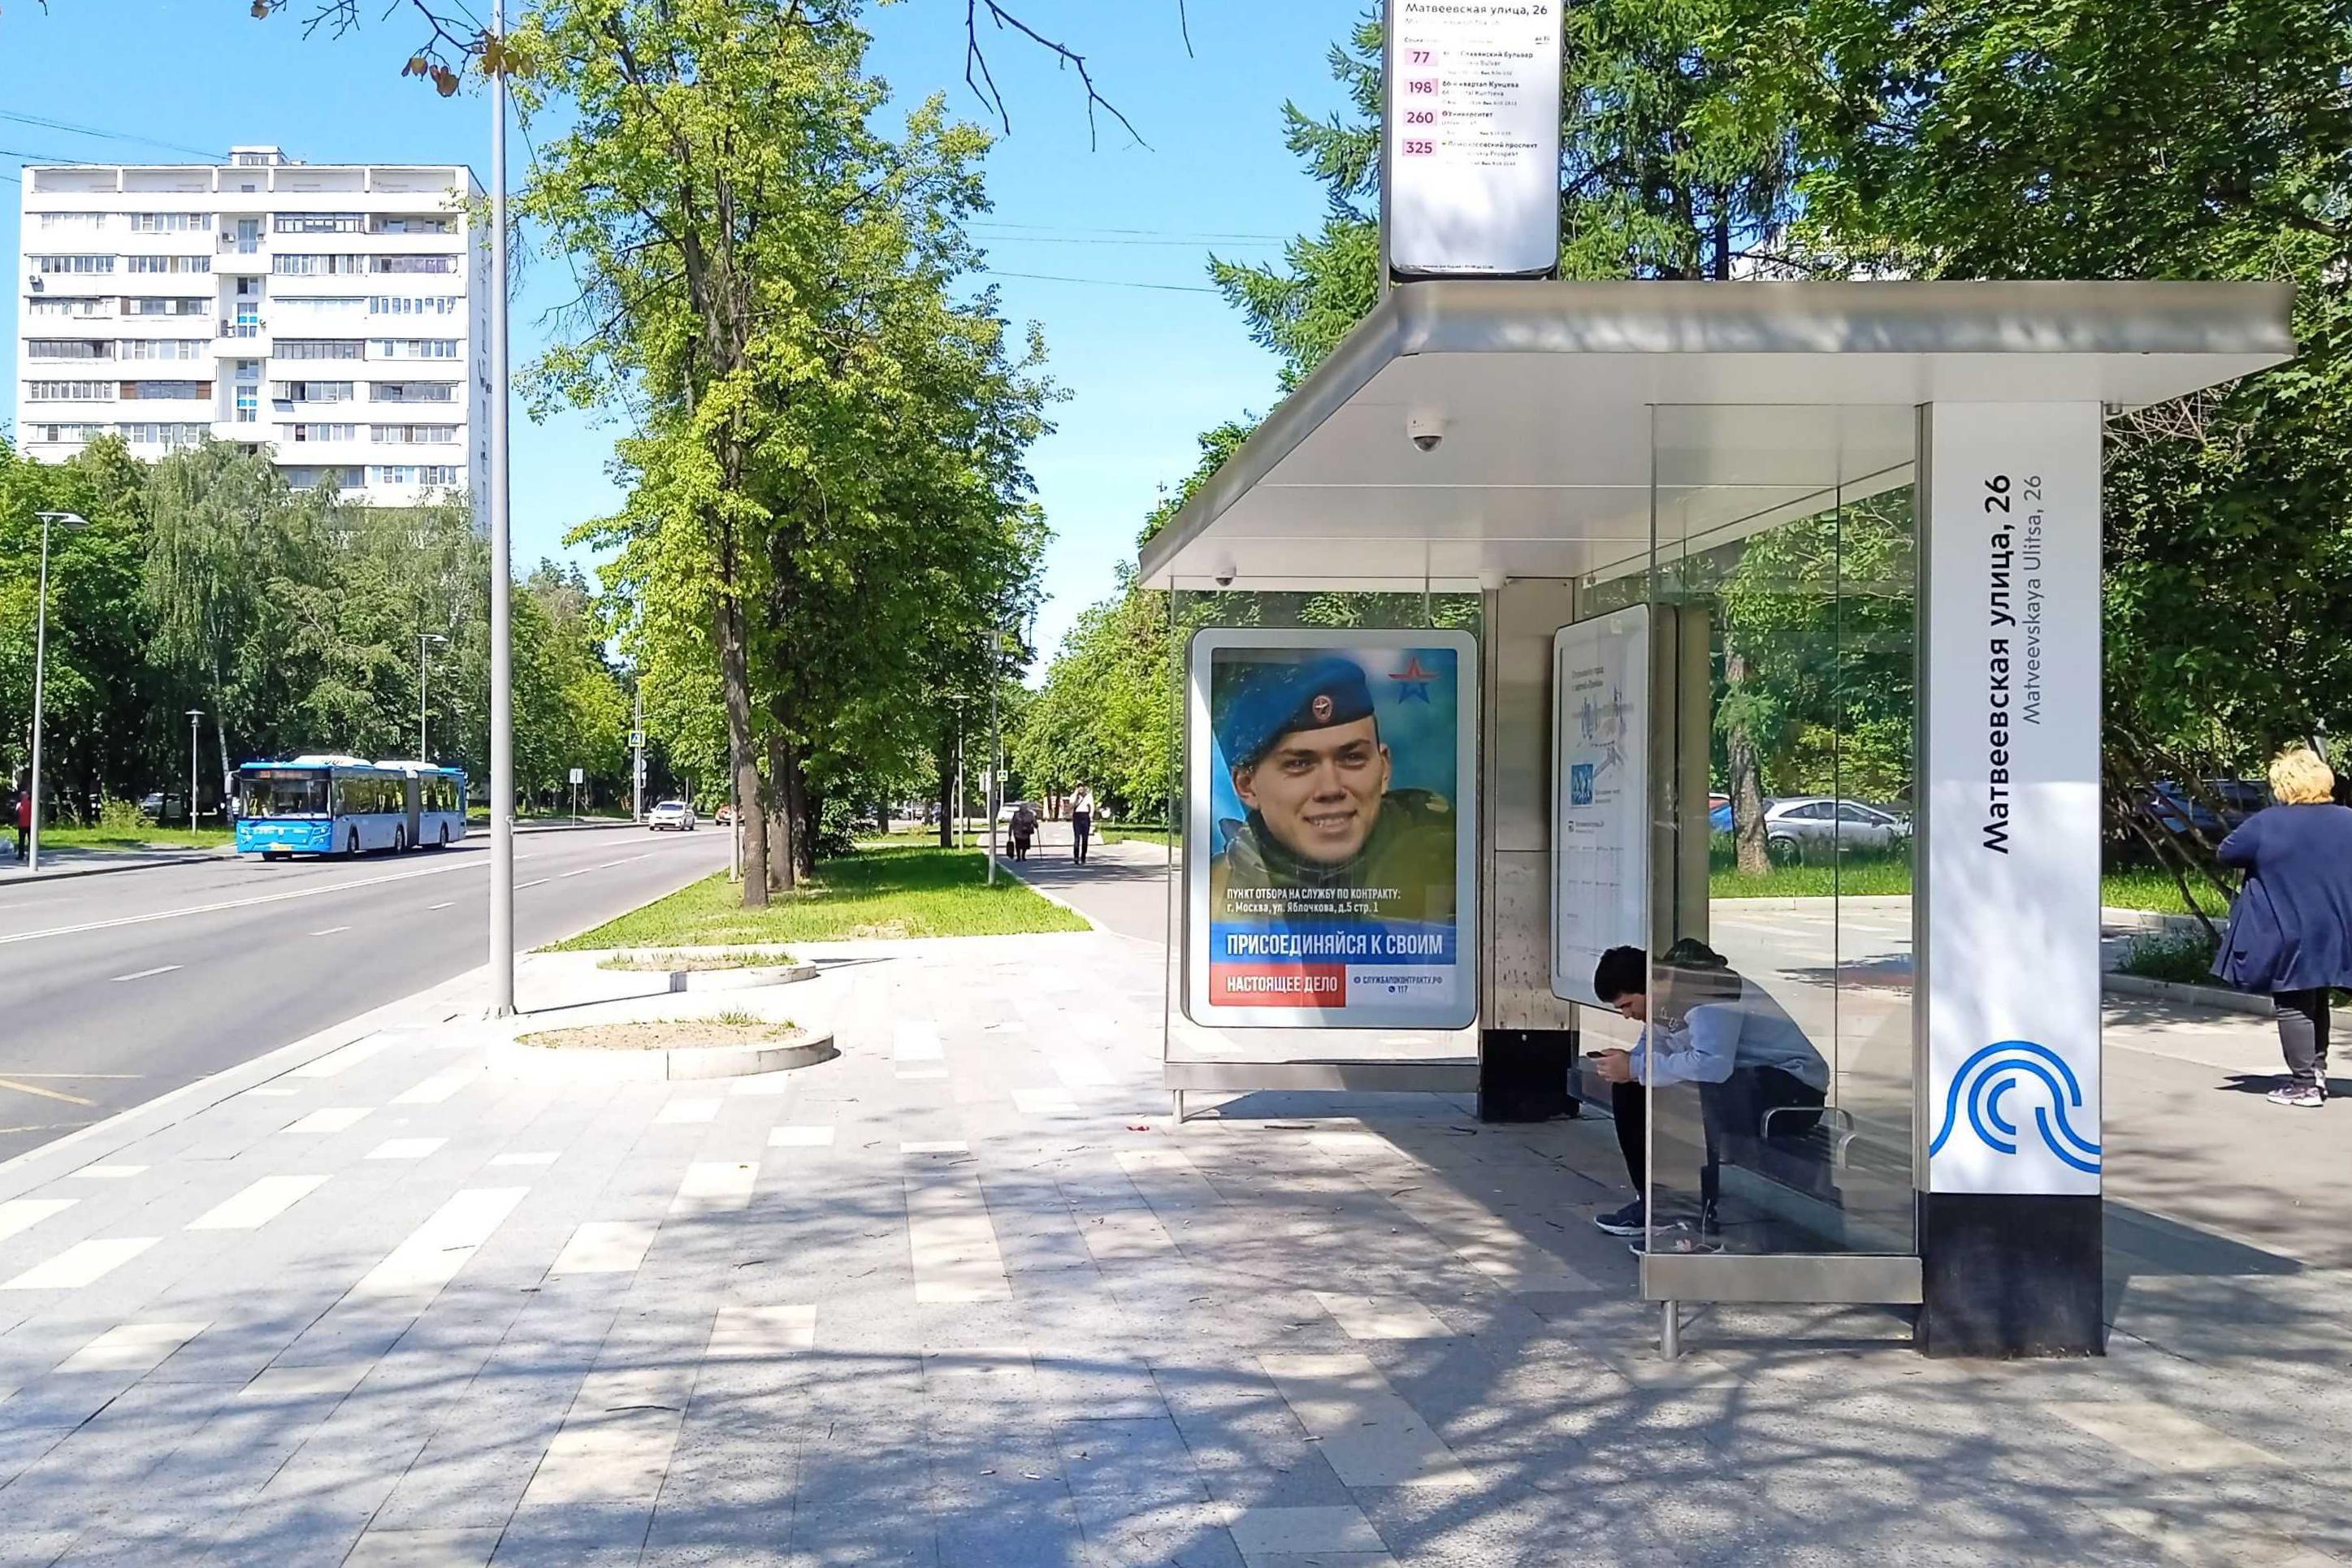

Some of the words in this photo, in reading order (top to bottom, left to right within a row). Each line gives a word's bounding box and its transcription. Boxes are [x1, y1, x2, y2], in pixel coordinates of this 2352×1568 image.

[1406, 3, 1486, 14] Матвеевская
[1491, 6, 1529, 16] улица,
[1532, 5, 1548, 15] 26
[1413, 51, 1430, 63] 77
[1410, 81, 1432, 93] 198
[1406, 111, 1434, 123] 260
[1406, 142, 1432, 154] 325
[1985, 474, 2011, 513] 26
[2023, 475, 2042, 500] 26
[2022, 509, 2044, 570] Ulitsa,
[1990, 524, 2016, 627] улица,
[2022, 578, 2045, 725] Matveevskaya
[1982, 639, 2010, 855] Матвеевская
[1227, 888, 1254, 899] ПУНКТ
[1255, 888, 1288, 899] ОТБОРА
[1289, 888, 1301, 899] НА
[1302, 888, 1335, 899] СЛУЖБУ
[1336, 888, 1349, 899] ПО
[1350, 888, 1401, 899] КОНТРАКТУ:
[1227, 903, 1234, 912] г.
[1287, 902, 1337, 914] Яблочкова,
[1354, 903, 1372, 915] стр.
[1373, 902, 1380, 912] 1
[1227, 930, 1367, 957] ПРИСОЕДИНЯЙСЯ
[1371, 934, 1382, 955] К
[1386, 934, 1443, 955] СВОИМ
[1227, 977, 1301, 994] НАСТОЯЩЕЕ
[1303, 977, 1338, 993] ДЕЛО
